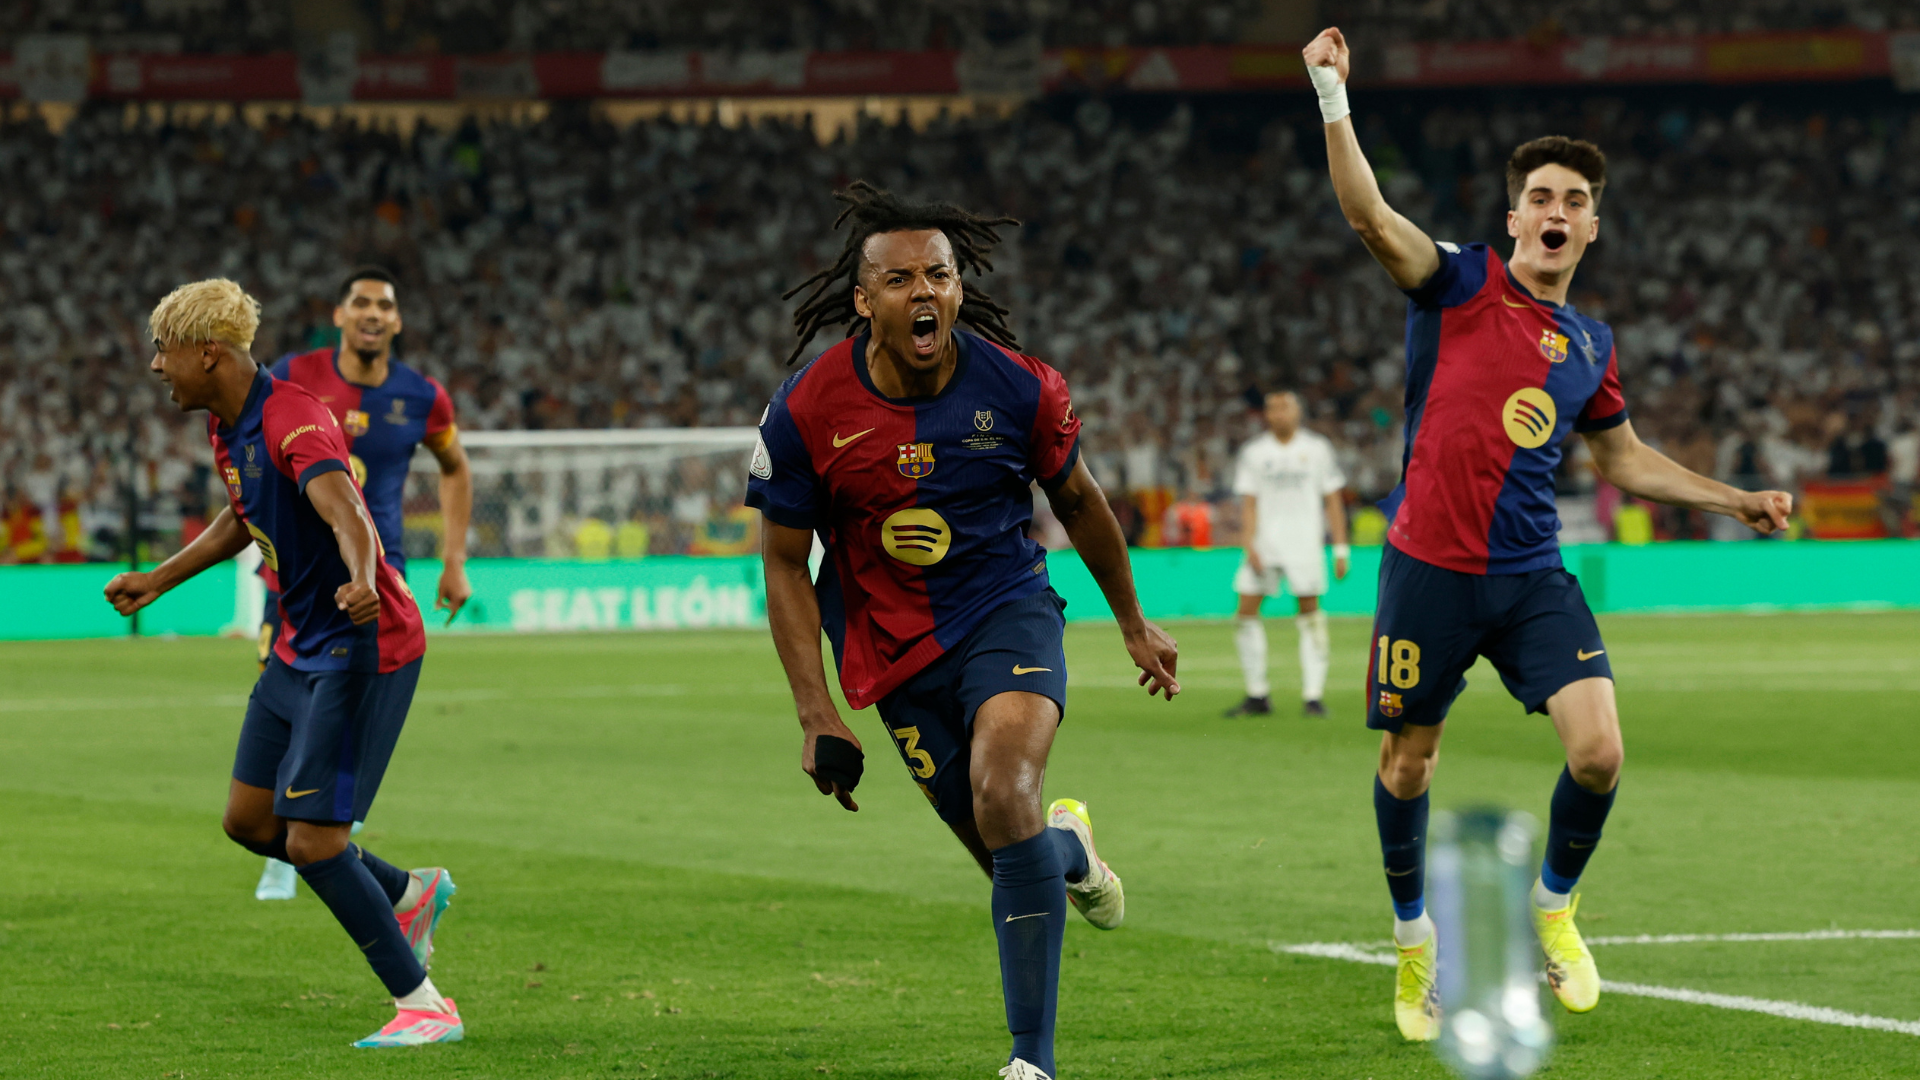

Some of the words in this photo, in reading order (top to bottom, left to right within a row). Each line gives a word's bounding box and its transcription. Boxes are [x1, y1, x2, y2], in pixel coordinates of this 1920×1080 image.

[510, 587, 625, 631] SEAT
[631, 575, 751, 630] LEÓN
[1378, 635, 1420, 689] 18
[885, 721, 936, 779] 3
